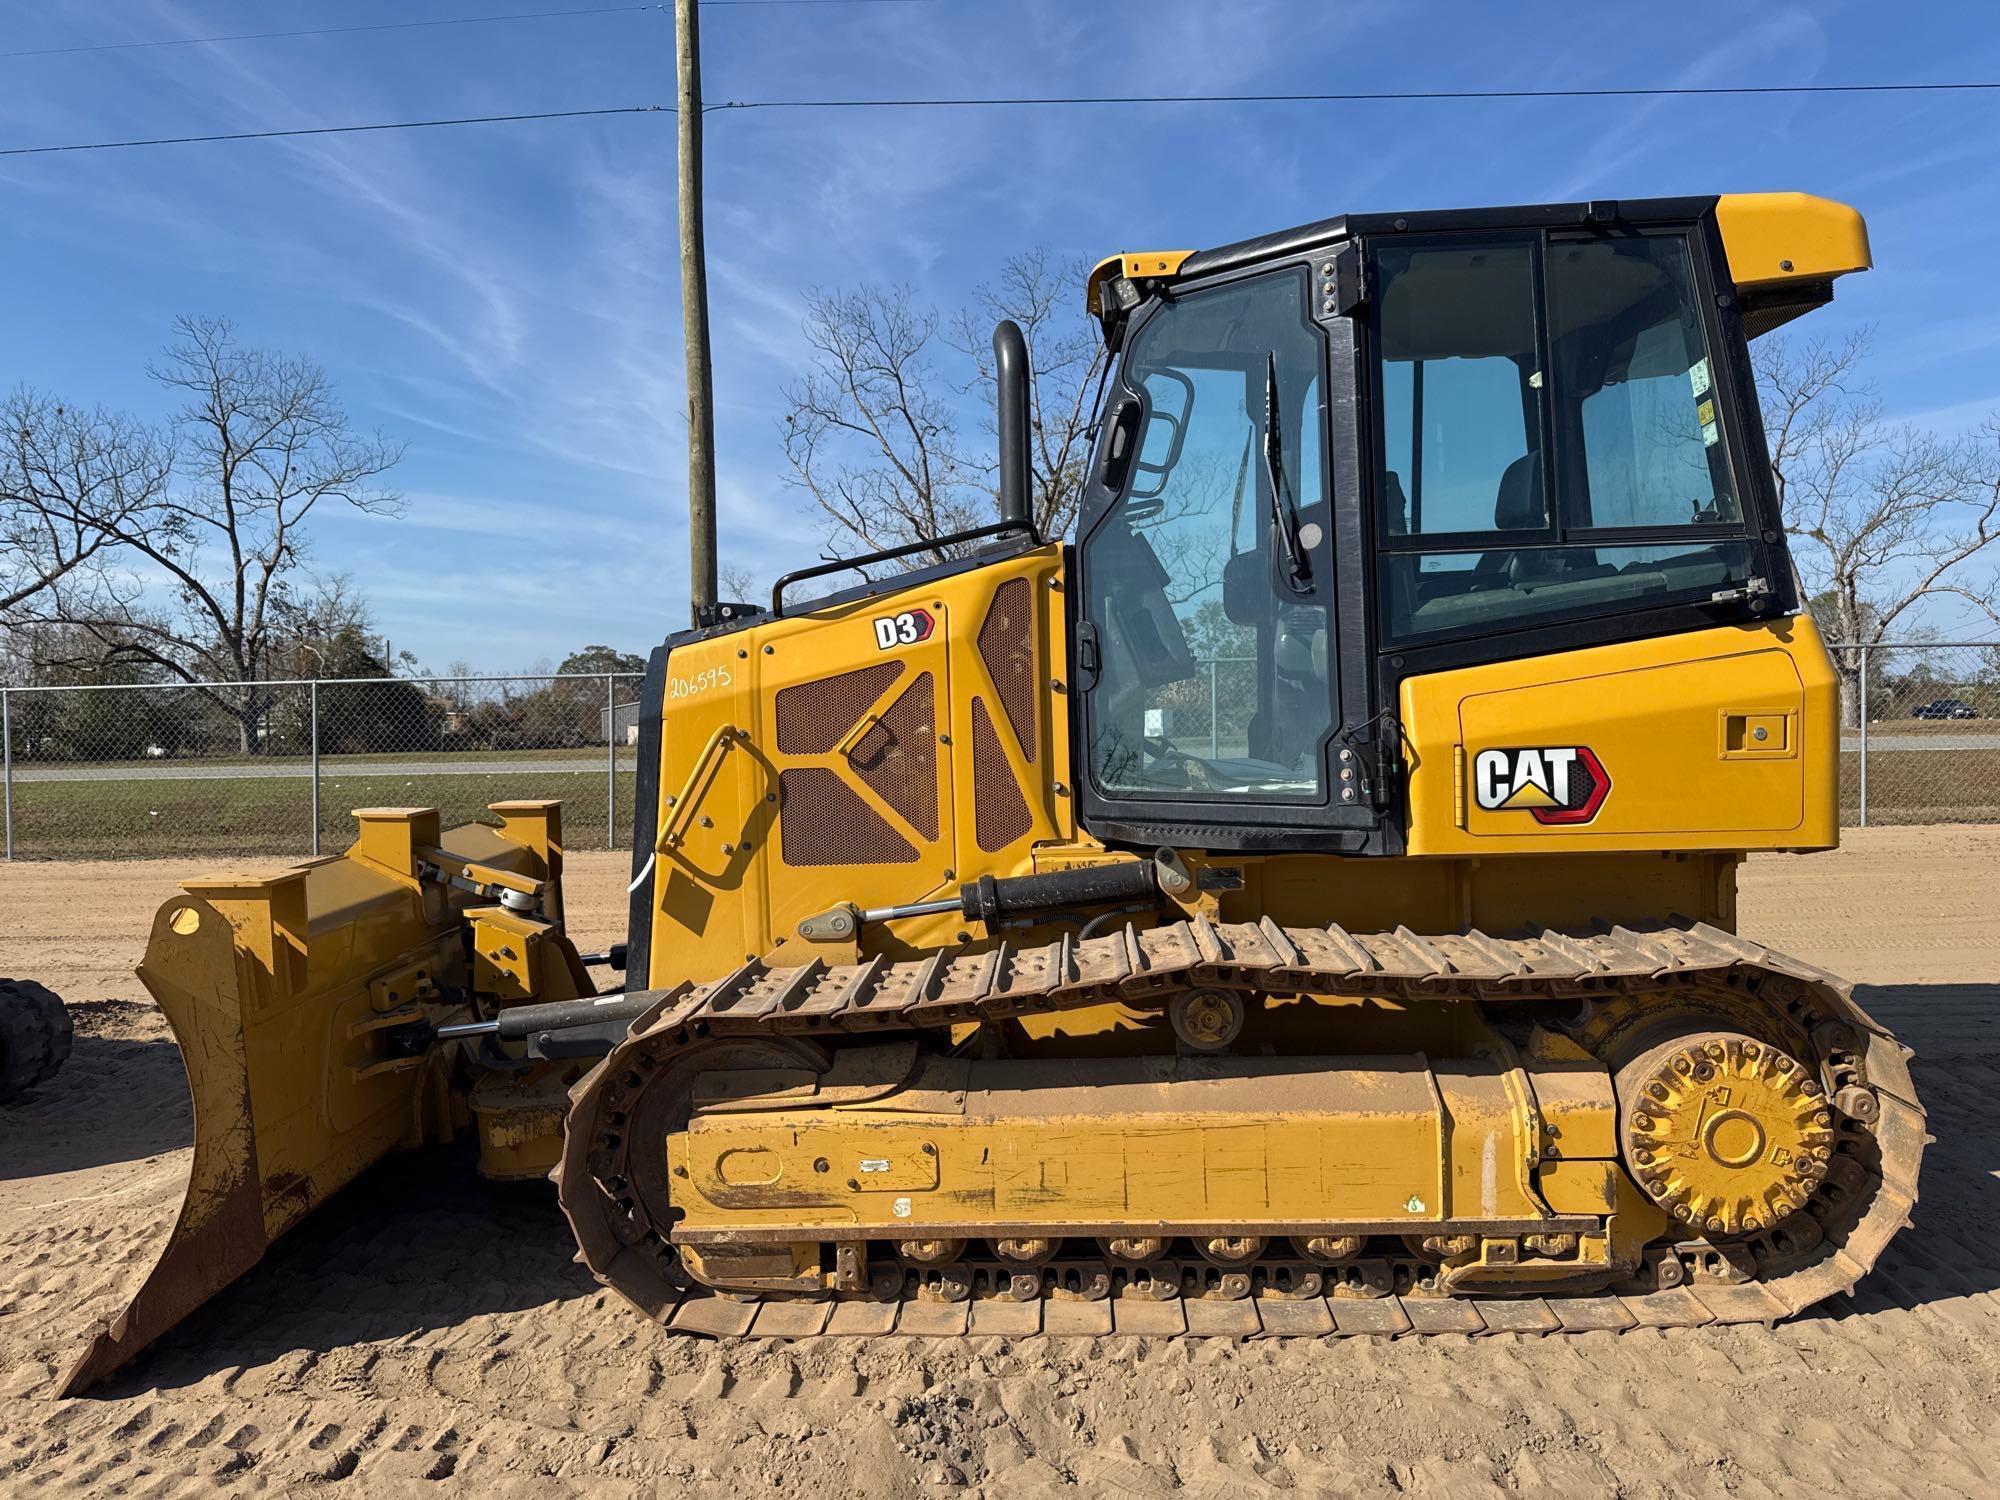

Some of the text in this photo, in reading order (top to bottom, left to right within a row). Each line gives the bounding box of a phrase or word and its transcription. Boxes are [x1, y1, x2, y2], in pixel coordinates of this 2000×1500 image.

[875, 612, 918, 650] D3
[670, 665, 732, 699] 206595
[1476, 748, 1576, 808] CAT
